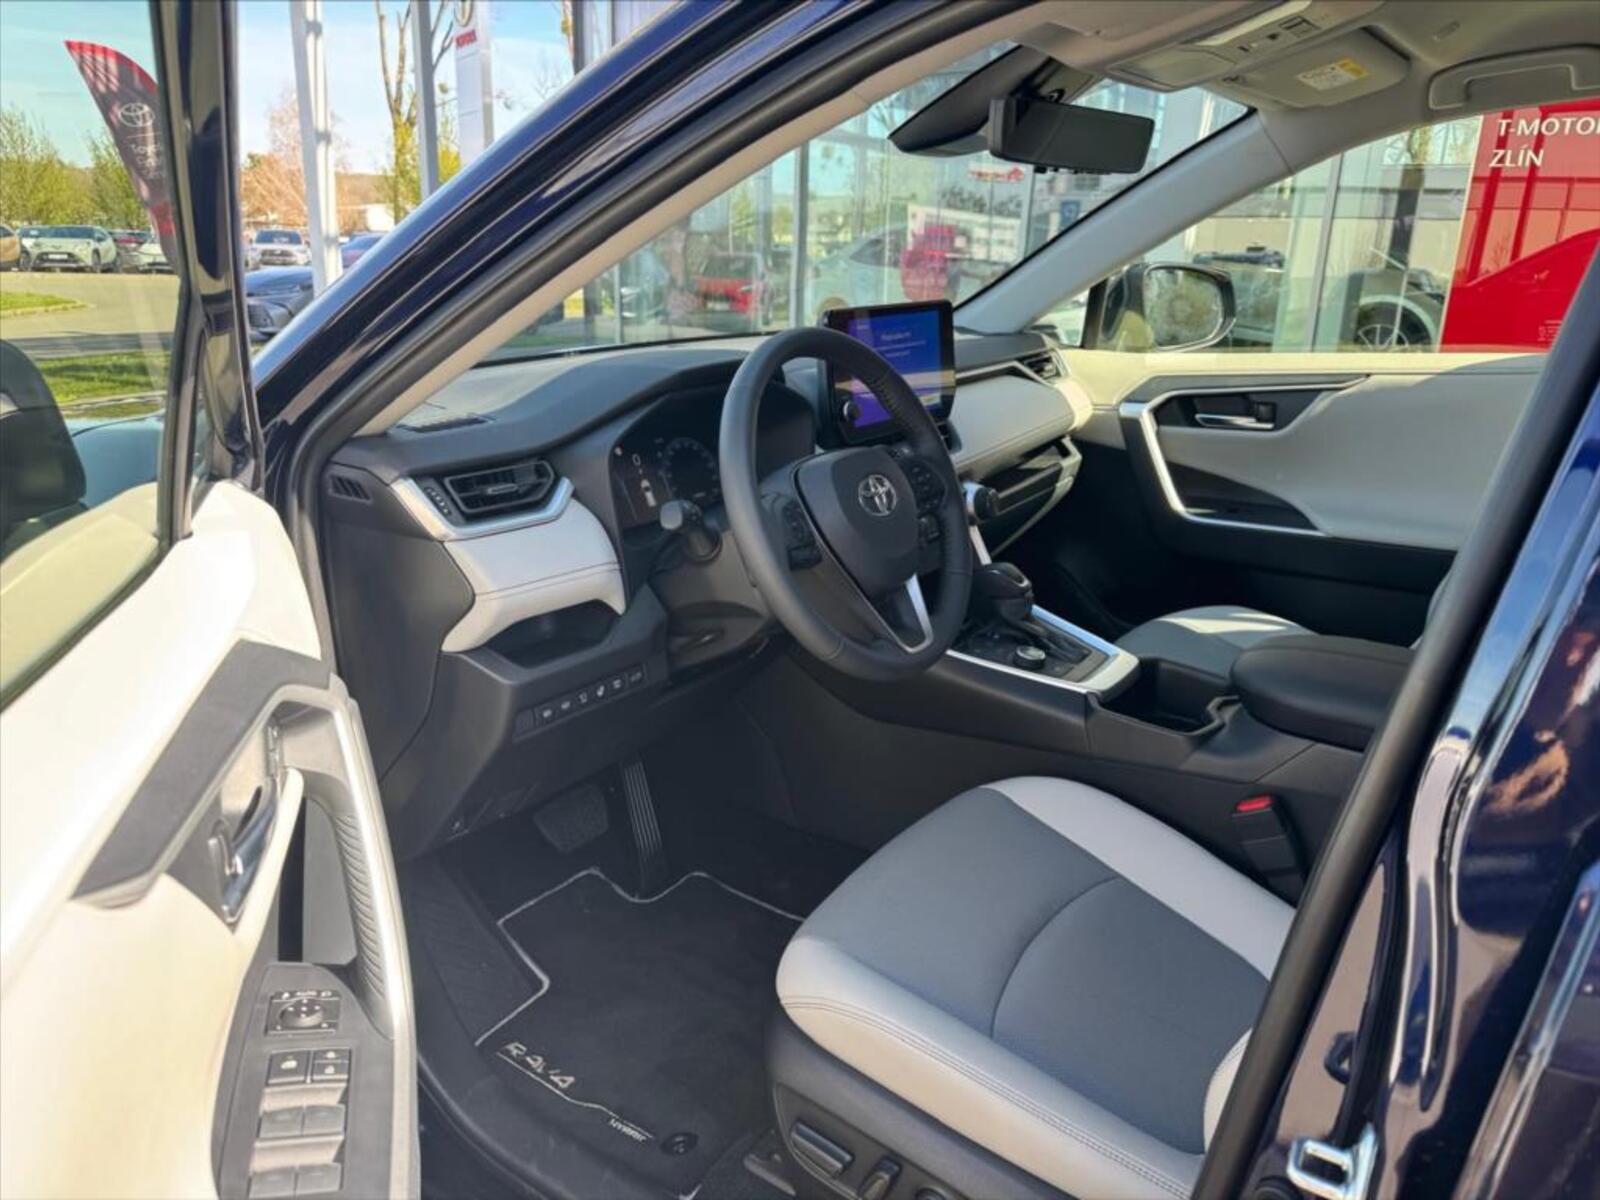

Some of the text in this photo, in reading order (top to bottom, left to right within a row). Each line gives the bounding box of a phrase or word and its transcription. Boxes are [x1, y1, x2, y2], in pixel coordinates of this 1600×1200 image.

[1498, 116, 1600, 136] T-MOTO
[1488, 144, 1544, 168] ZLÍN
[505, 1042, 575, 1088] RAV4
